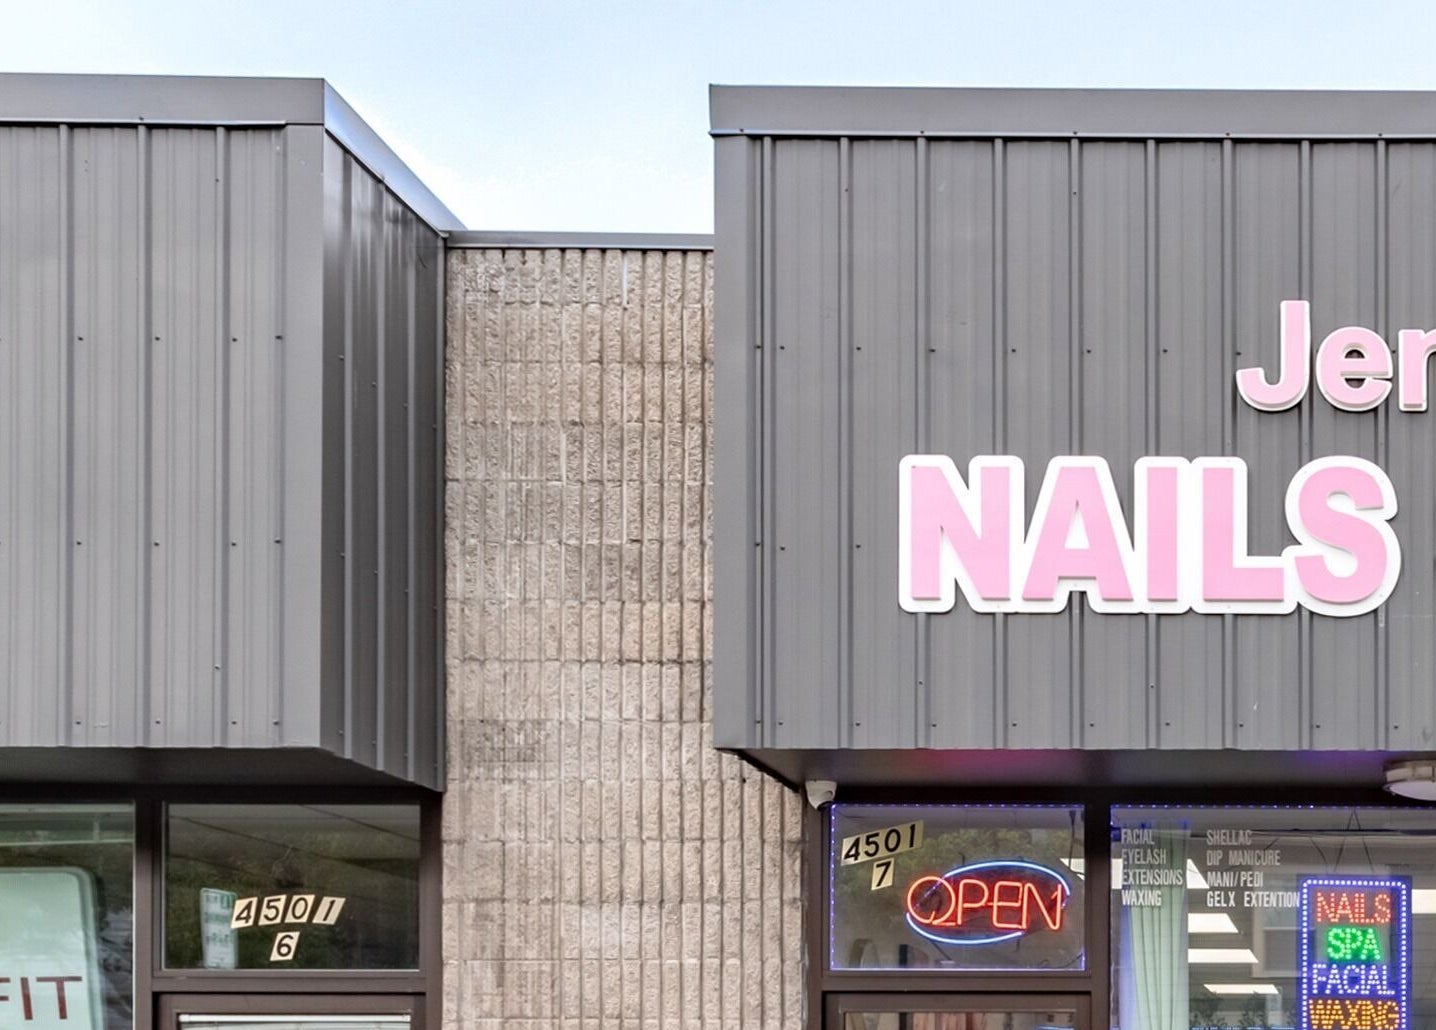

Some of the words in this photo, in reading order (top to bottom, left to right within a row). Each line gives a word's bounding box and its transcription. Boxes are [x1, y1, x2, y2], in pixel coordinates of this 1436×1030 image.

[898, 453, 1401, 617] NAILS
[842, 823, 917, 862] 4501
[1121, 828, 1155, 845] FACIAL
[1206, 829, 1252, 846] SHELLAC
[1121, 848, 1167, 865] EYELASH
[1206, 850, 1223, 866] DIP
[1229, 849, 1281, 866] MANICURE
[875, 860, 892, 888] 7
[1121, 868, 1184, 886] EXTENSIONS
[234, 897, 337, 925] 4501
[907, 875, 1063, 931] OPEN
[1121, 890, 1162, 907] WAXING
[1244, 891, 1301, 908] EXTENTION
[1316, 892, 1392, 924] NAILS
[276, 934, 294, 957] 6
[1327, 927, 1381, 961] SPA
[1312, 963, 1396, 995] FACIAL
[1308, 999, 1400, 1030] WAXING
